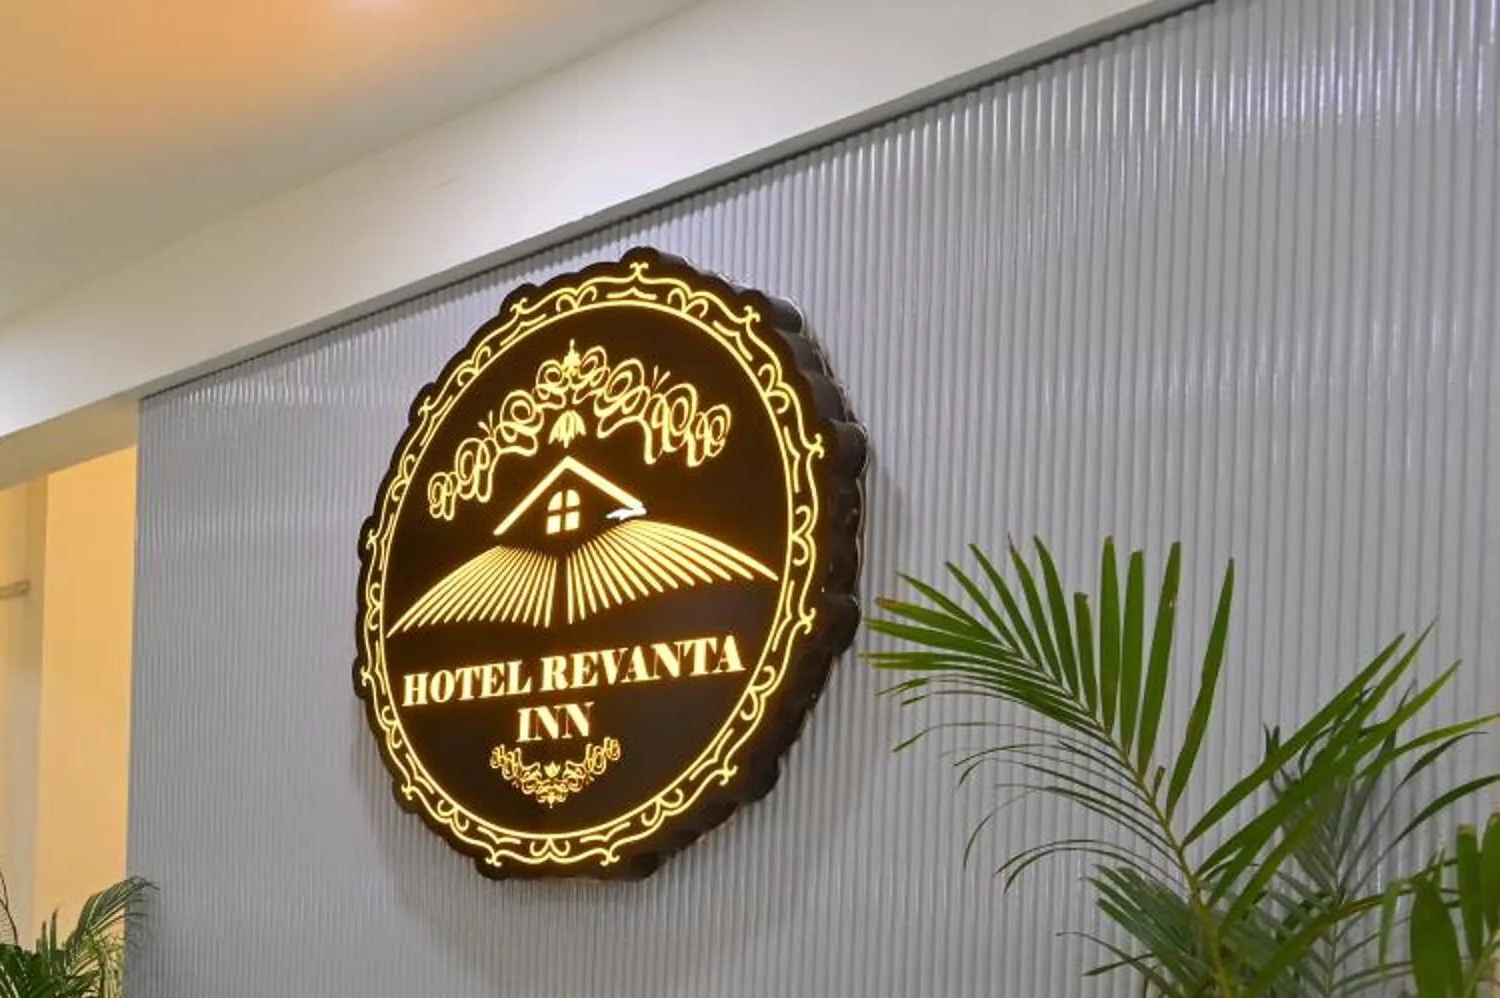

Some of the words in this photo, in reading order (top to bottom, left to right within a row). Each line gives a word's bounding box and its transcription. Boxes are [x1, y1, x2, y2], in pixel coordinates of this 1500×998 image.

[401, 659, 533, 706] HOTEL
[540, 634, 746, 693] REVANTA
[516, 701, 595, 742] INN
